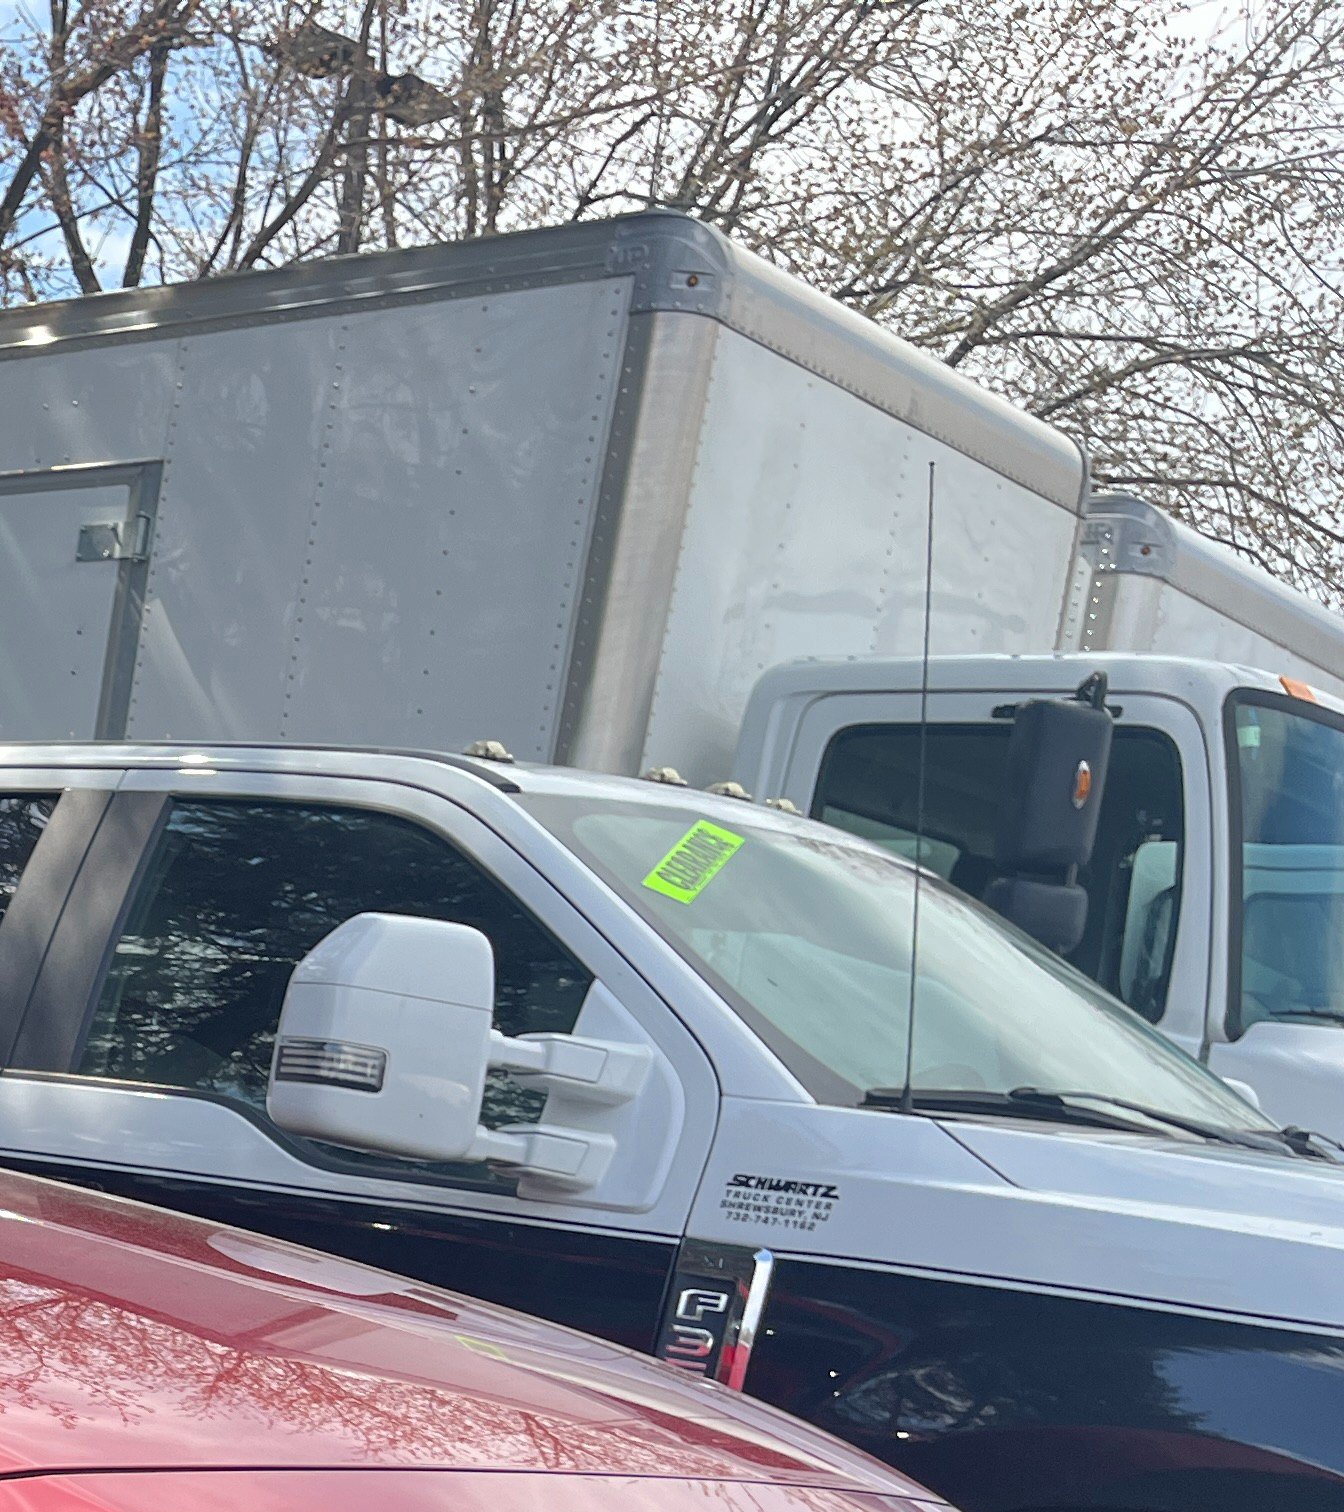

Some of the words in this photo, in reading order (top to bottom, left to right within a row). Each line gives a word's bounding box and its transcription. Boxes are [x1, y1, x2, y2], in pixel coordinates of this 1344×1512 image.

[726, 1174, 839, 1200] SCHWARTZ
[726, 1189, 770, 1203] TRUCK
[775, 1196, 832, 1210] CENTER
[812, 1211, 830, 1222] NJ
